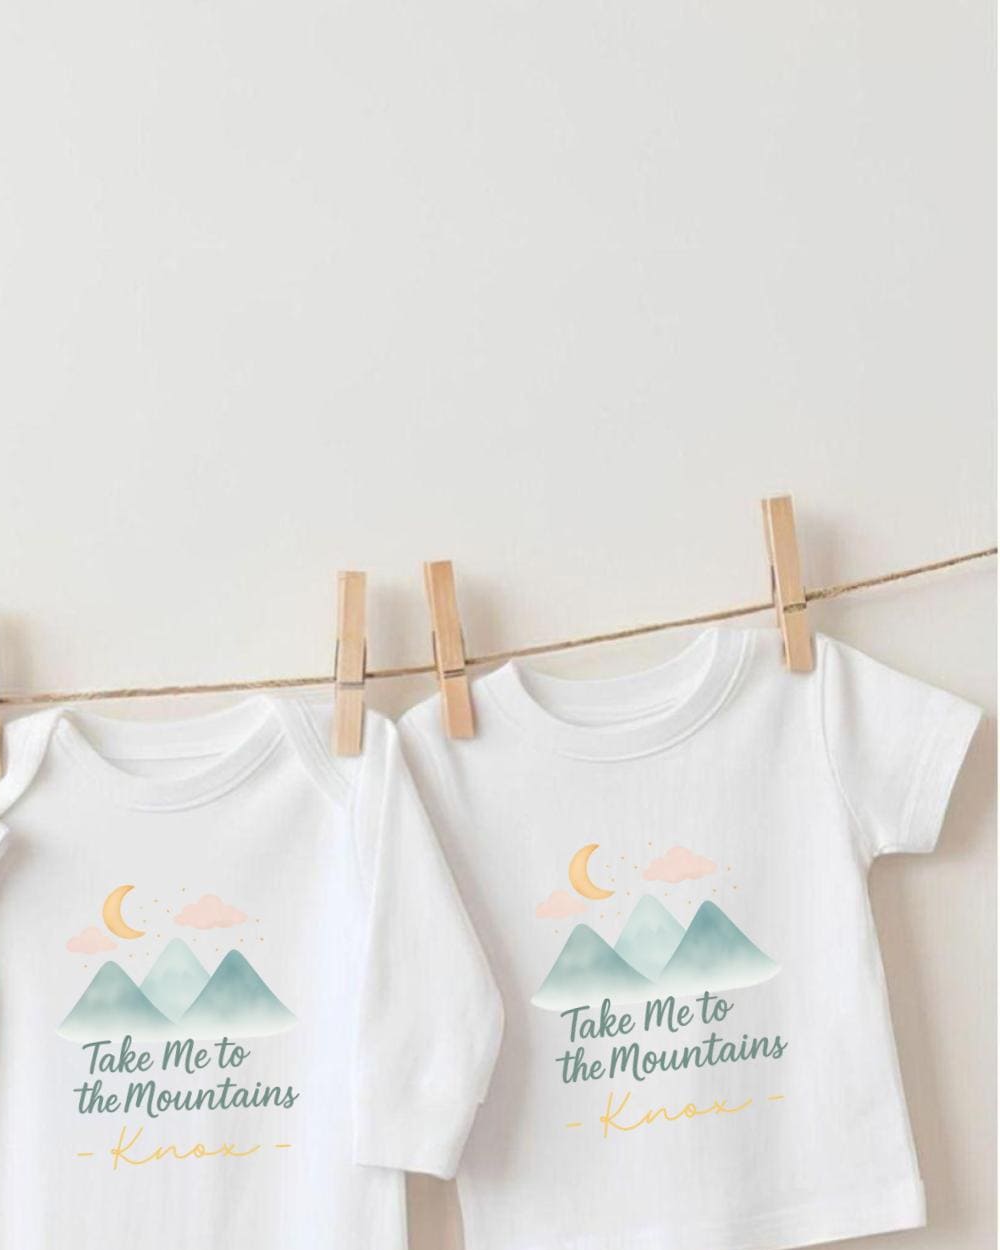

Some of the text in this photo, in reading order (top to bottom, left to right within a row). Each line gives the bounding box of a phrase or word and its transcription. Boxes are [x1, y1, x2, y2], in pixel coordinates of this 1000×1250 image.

[560, 990, 735, 1043] Take Me to
[82, 1034, 251, 1075] Take Me to
[555, 1032, 788, 1084] the Mountains
[73, 1077, 300, 1118] the Mountains
[599, 1091, 753, 1138] Knox
[110, 1126, 261, 1170] Knox
